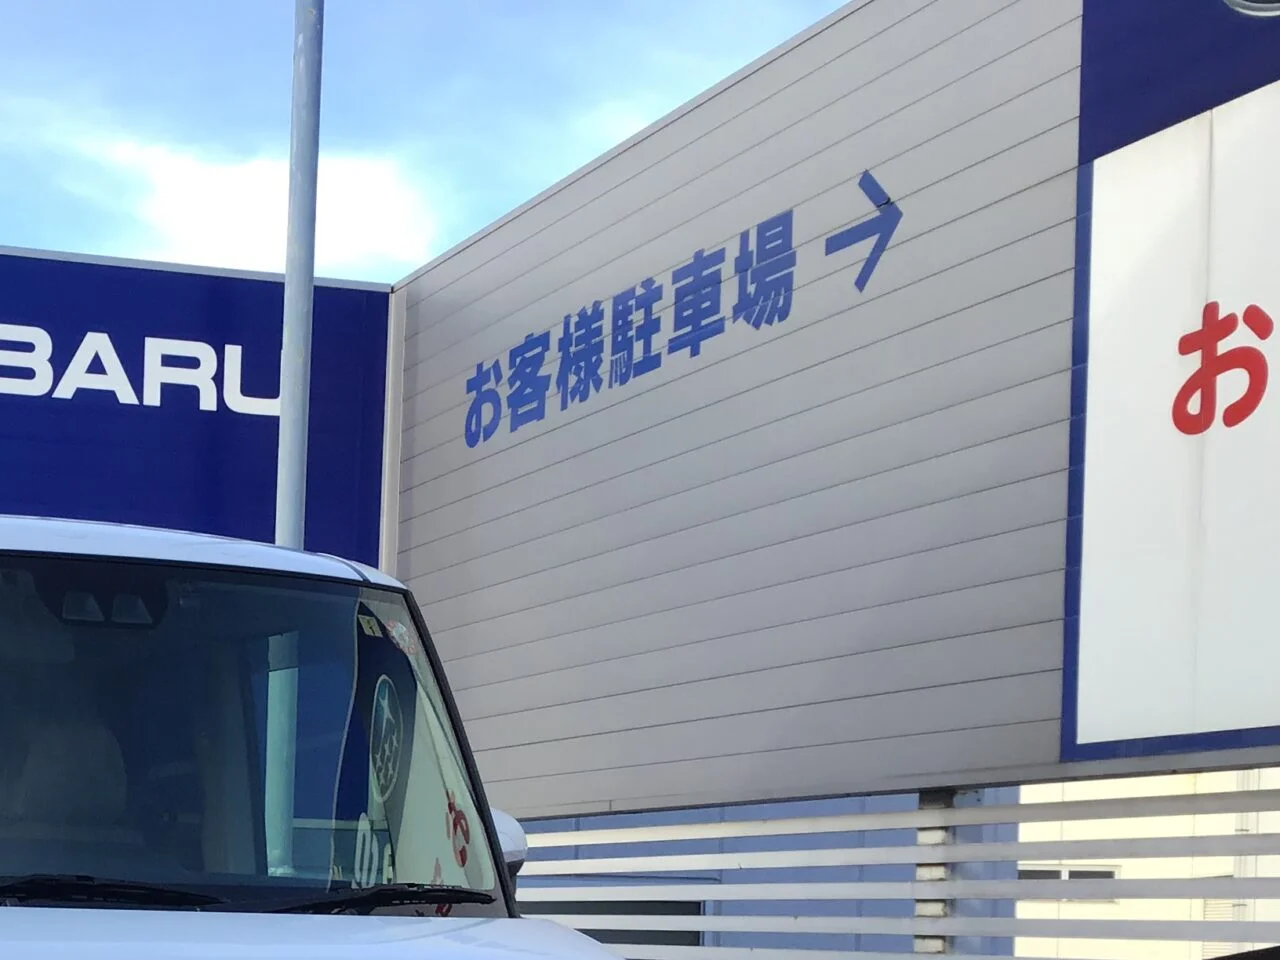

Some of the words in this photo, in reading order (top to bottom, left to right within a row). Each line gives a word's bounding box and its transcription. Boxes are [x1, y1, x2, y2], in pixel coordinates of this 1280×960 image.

[464, 208, 796, 449] お客様駐車場
[1172, 301, 1274, 435] お
